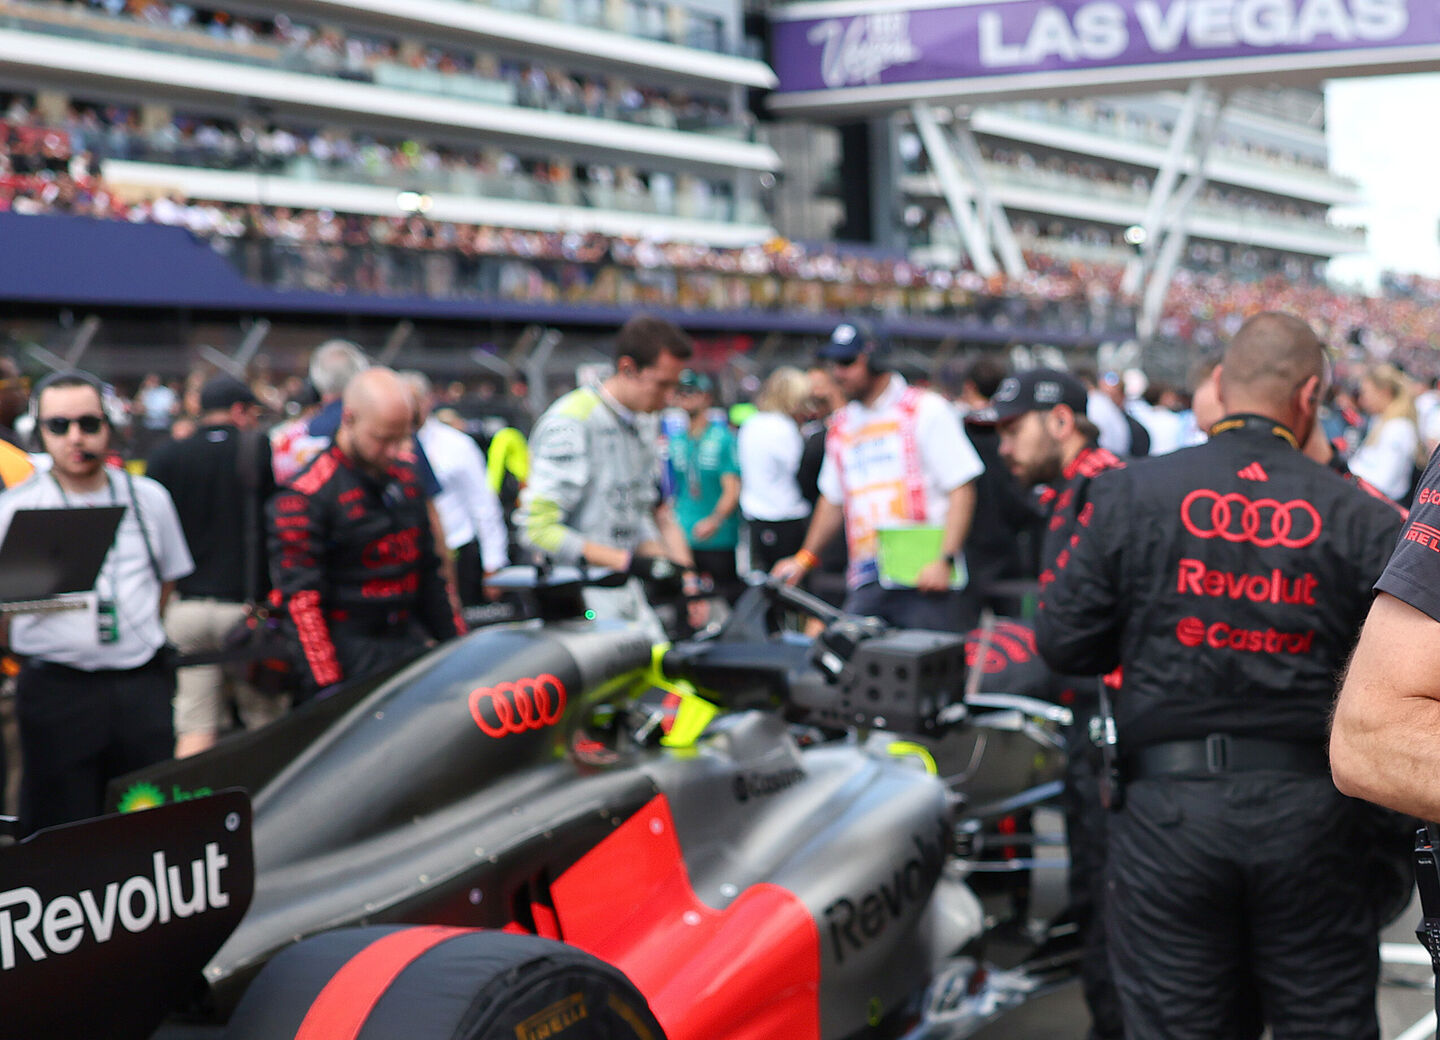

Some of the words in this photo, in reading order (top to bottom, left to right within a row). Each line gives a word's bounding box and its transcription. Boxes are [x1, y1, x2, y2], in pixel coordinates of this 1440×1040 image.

[977, 6, 1131, 68] LAS
[1135, 0, 1411, 53] VEGAS
[1176, 557, 1319, 606] Revolut
[1206, 621, 1316, 655] Castrol
[0, 842, 230, 971] Revolut
